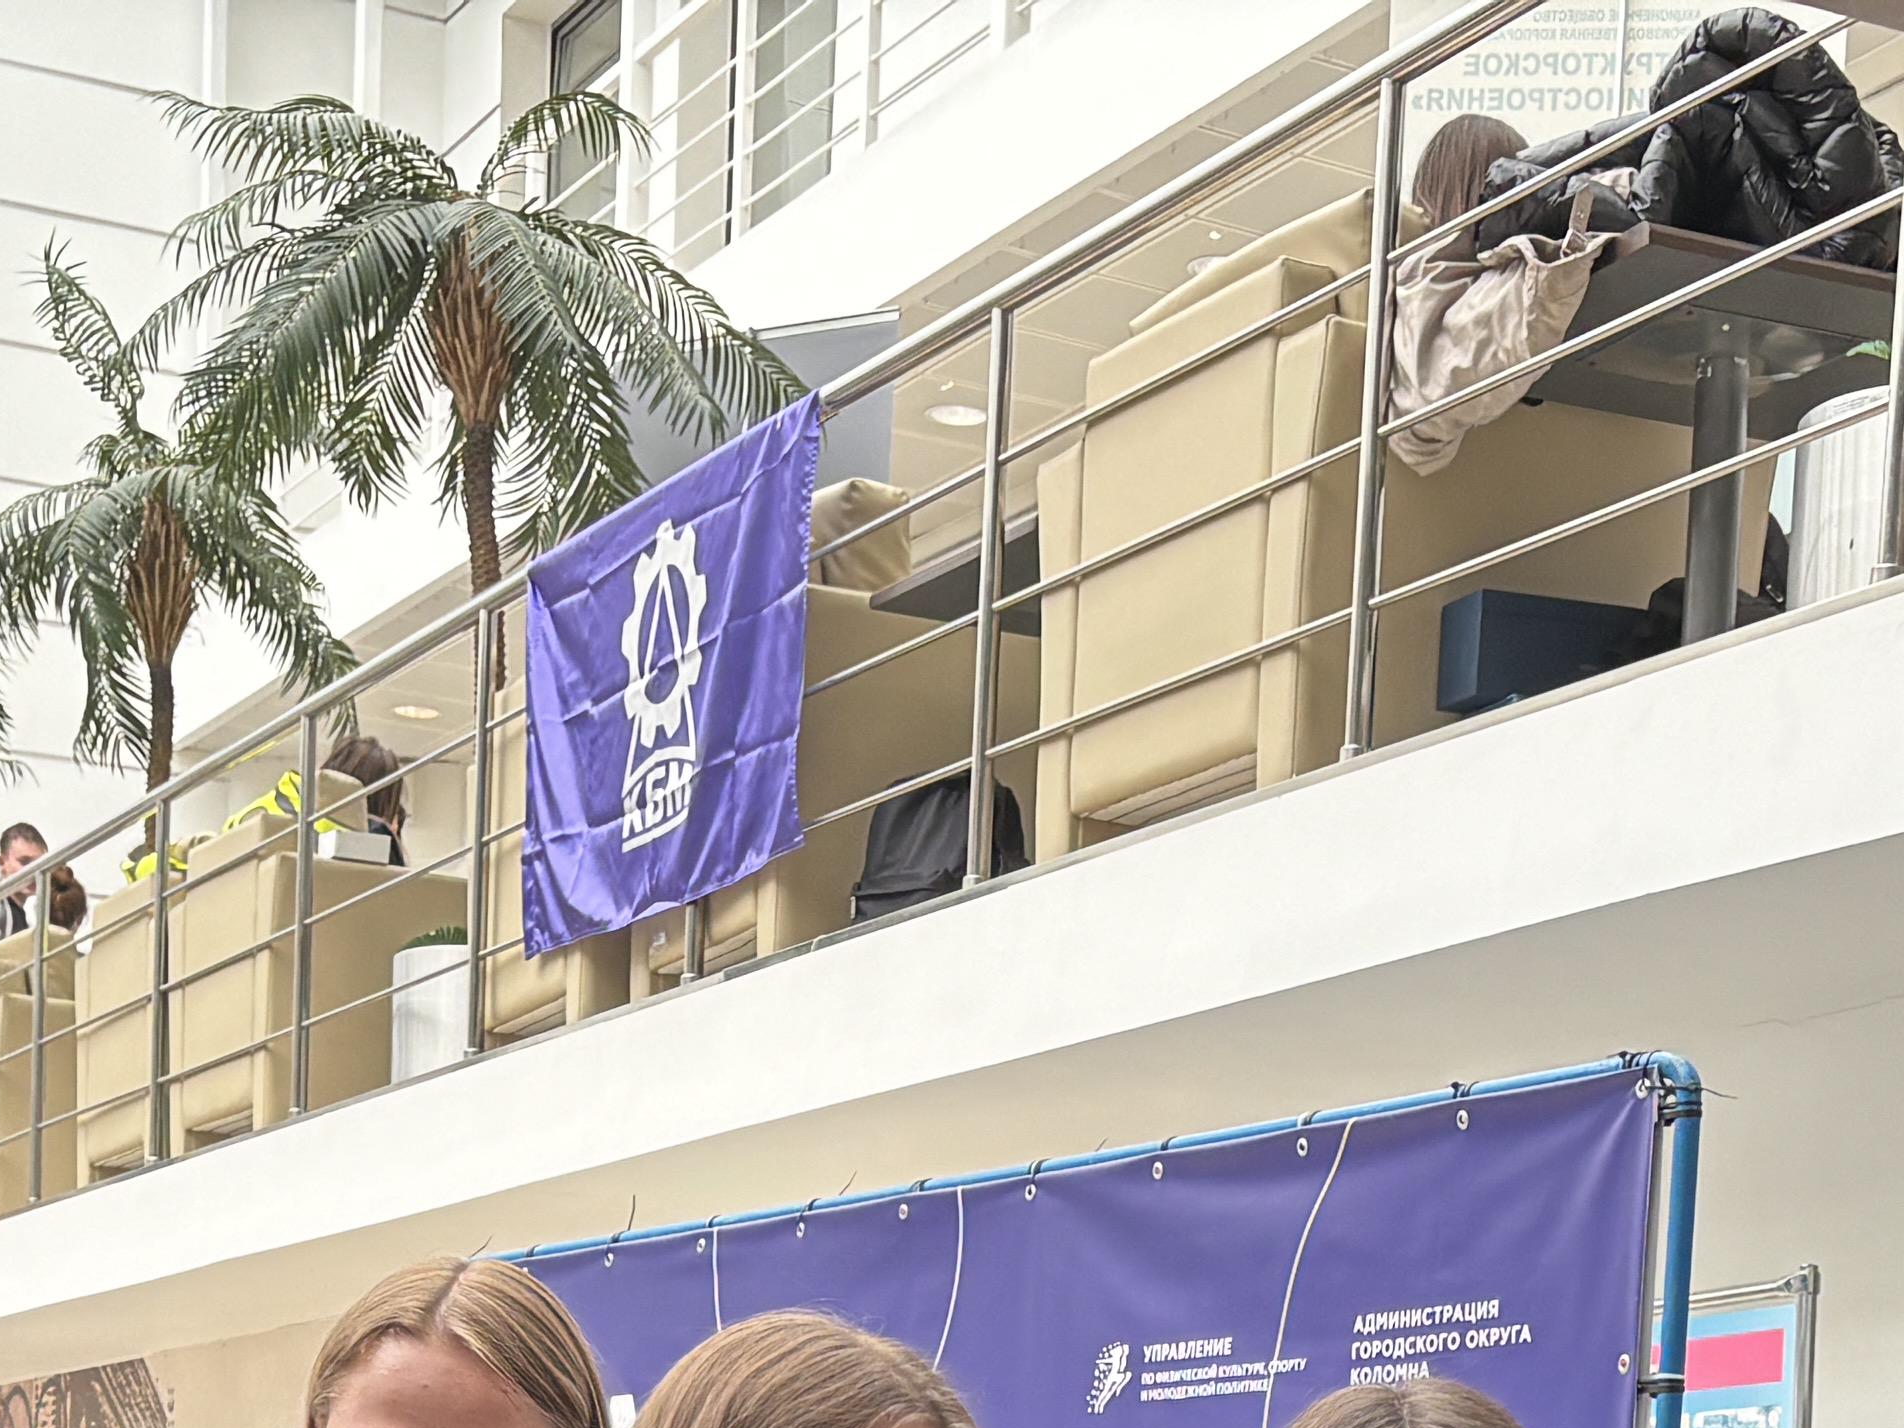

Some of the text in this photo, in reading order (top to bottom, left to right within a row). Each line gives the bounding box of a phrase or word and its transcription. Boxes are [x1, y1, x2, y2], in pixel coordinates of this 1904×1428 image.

[1353, 1298, 1499, 1335] АДМИНИСТРАЦИЯ
[1142, 1337, 1233, 1363] УПРАВЛЕНИЕ
[1351, 1325, 1532, 1360] ГОРОДСКОГО ОКРУГА
[1141, 1372, 1154, 1385] ПО
[1156, 1365, 1217, 1385] ФИЗИЧЕСКОЙ
[1269, 1358, 1307, 1374] СПОРТУ
[1350, 1361, 1430, 1387] КОЛОМНА
[1141, 1378, 1270, 1401] И МОЛОДЕЖНОЙ ПОЛИТИКЕ
